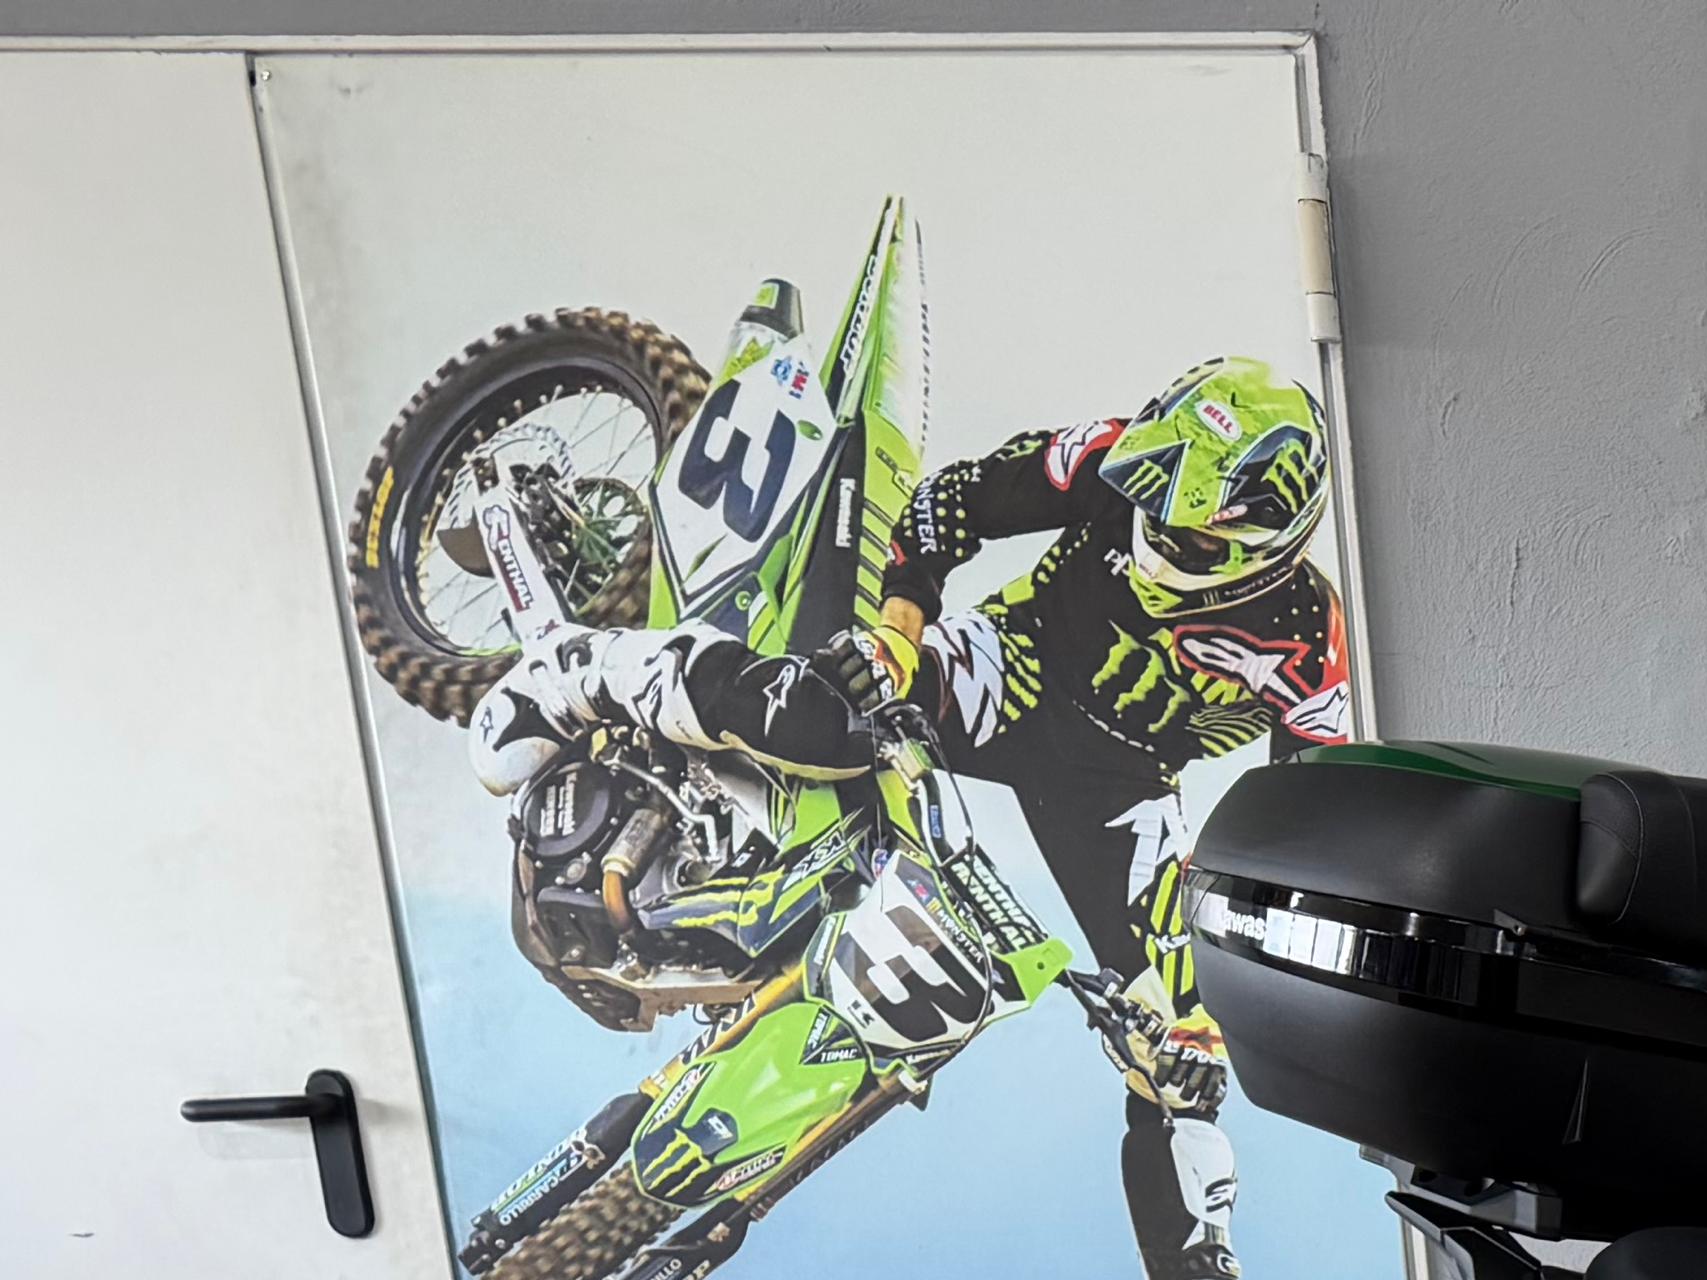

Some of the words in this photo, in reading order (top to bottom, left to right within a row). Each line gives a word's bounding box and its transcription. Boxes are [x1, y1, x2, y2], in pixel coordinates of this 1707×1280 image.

[679, 378, 796, 543] 3
[1202, 403, 1234, 434] BELL
[832, 904, 996, 1042] 3
[819, 1048, 857, 1063] TOMAC
